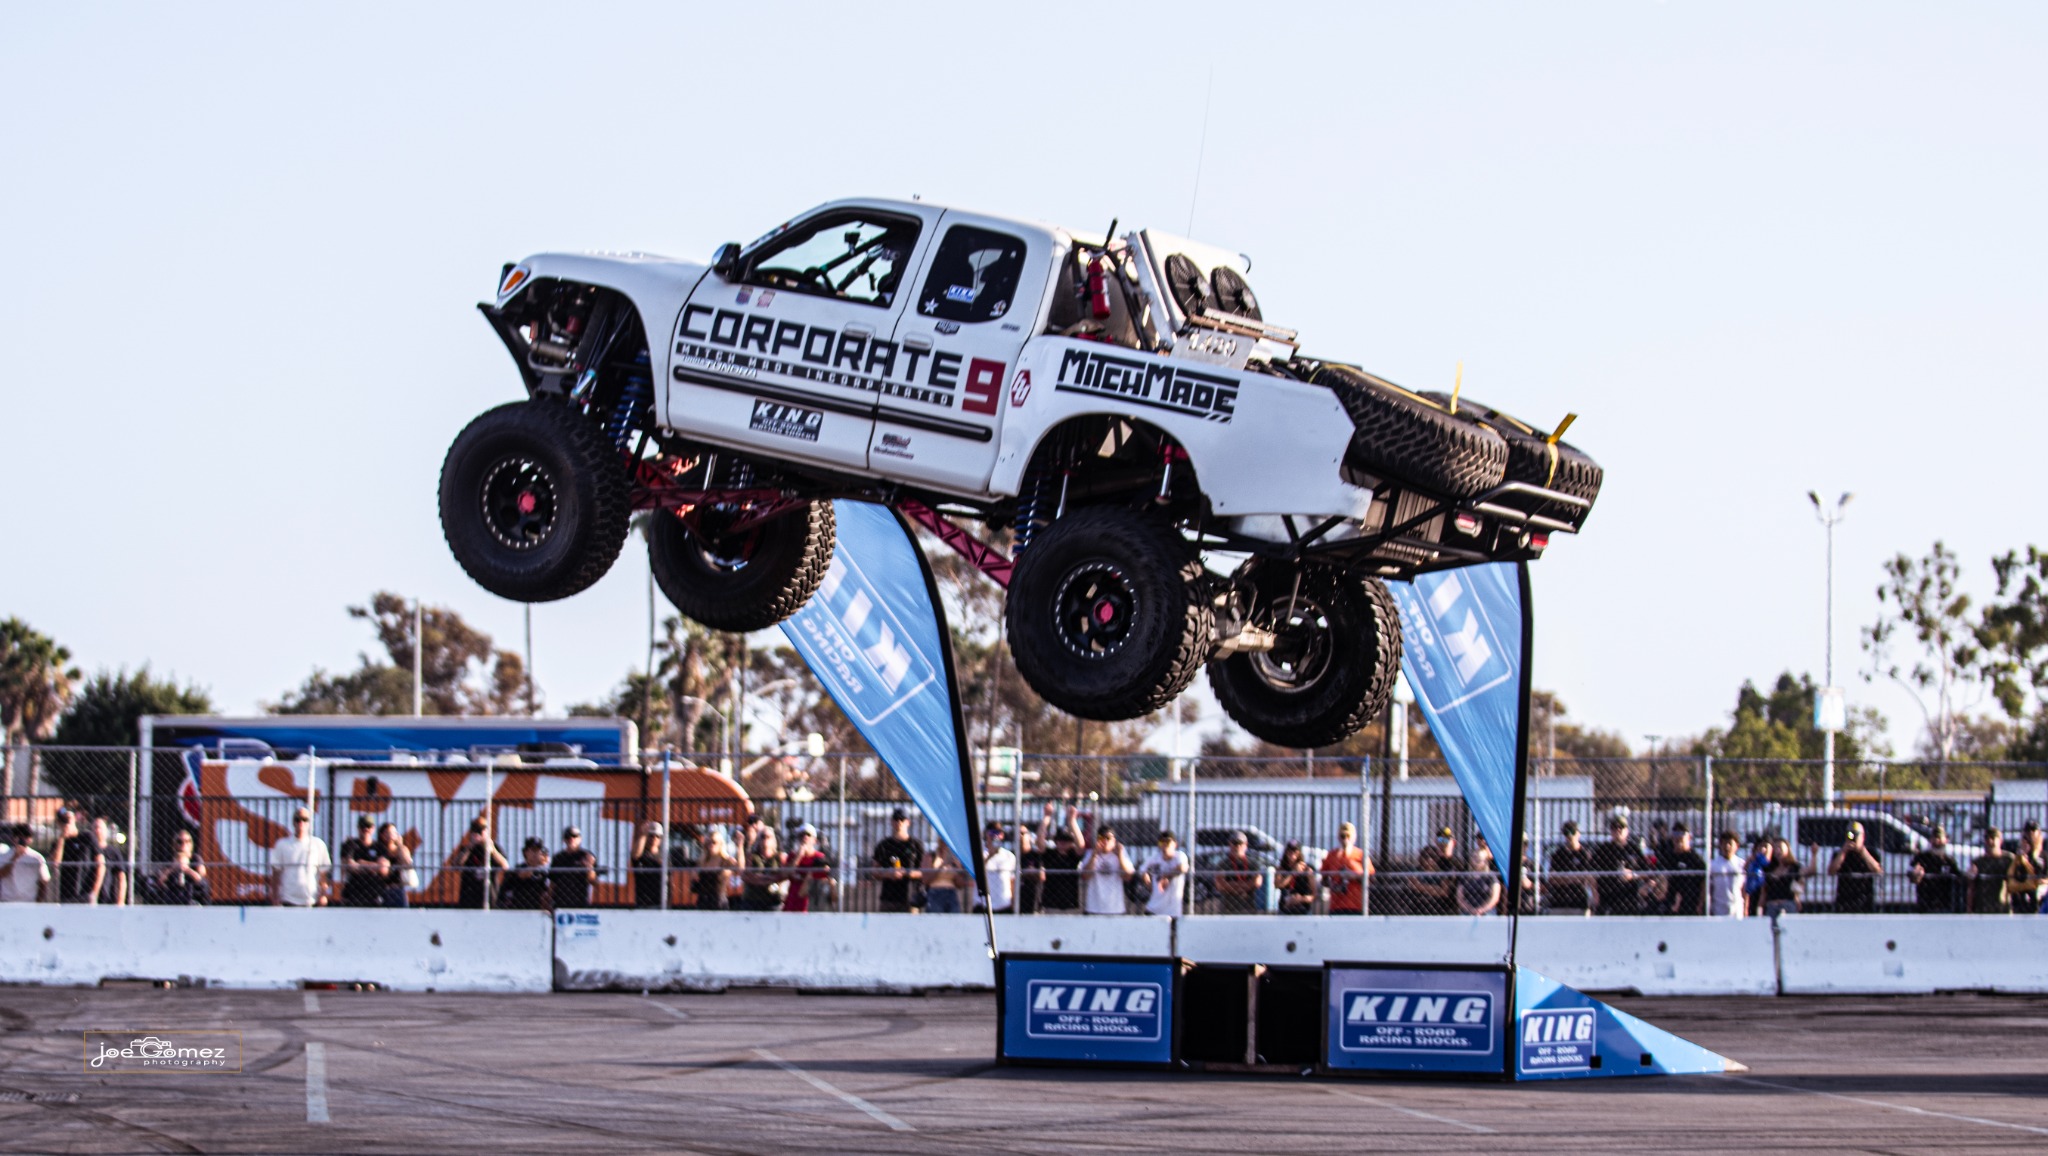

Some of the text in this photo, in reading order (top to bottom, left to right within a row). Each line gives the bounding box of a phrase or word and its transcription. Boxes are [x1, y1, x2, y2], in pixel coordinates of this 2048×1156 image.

[679, 303, 1006, 416] CORPORATE 9
[682, 343, 736, 363] MITCH
[748, 357, 794, 375] MADE
[755, 402, 822, 426] KING
[1033, 986, 1156, 1013] KING
[1347, 995, 1488, 1023] KING
[1043, 1023, 1090, 1032] RACING
[1058, 1015, 1082, 1023] OFF
[1092, 1016, 1129, 1024] ROAD
[1376, 1027, 1404, 1036] OFF
[1414, 1027, 1456, 1036] ROAD
[1524, 1014, 1593, 1042] KING
[1359, 1035, 1412, 1044] RACING
